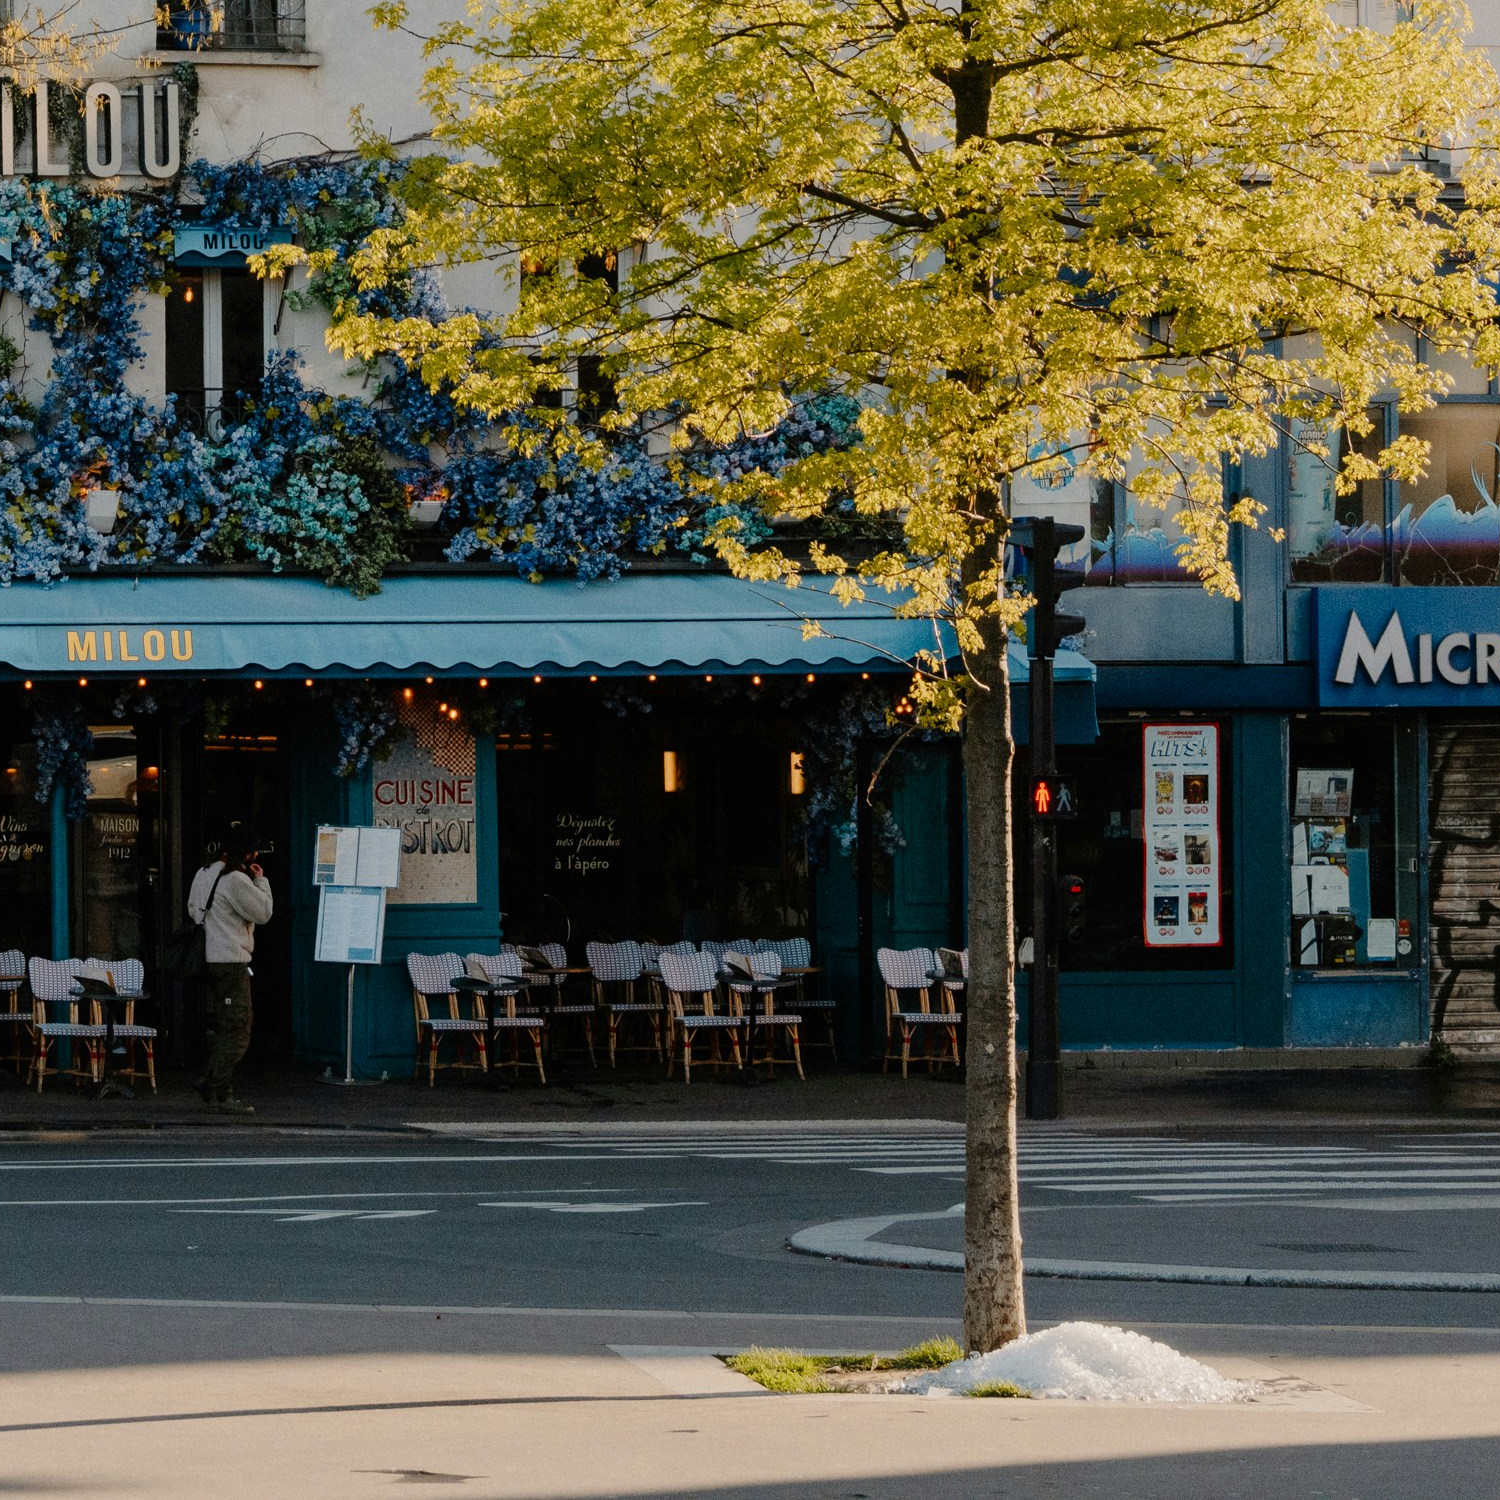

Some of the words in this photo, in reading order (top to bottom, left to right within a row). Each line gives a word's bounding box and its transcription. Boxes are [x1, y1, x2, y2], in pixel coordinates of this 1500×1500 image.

[203, 232, 265, 250] MILOU
[66, 629, 194, 662] MILOU
[374, 779, 473, 806] CUISINE
[100, 818, 140, 833] MAISON
[556, 811, 617, 835] Dégustez
[374, 817, 476, 855] STROT
[555, 836, 574, 848] nos
[576, 834, 621, 853] planches
[108, 847, 131, 859] 1912
